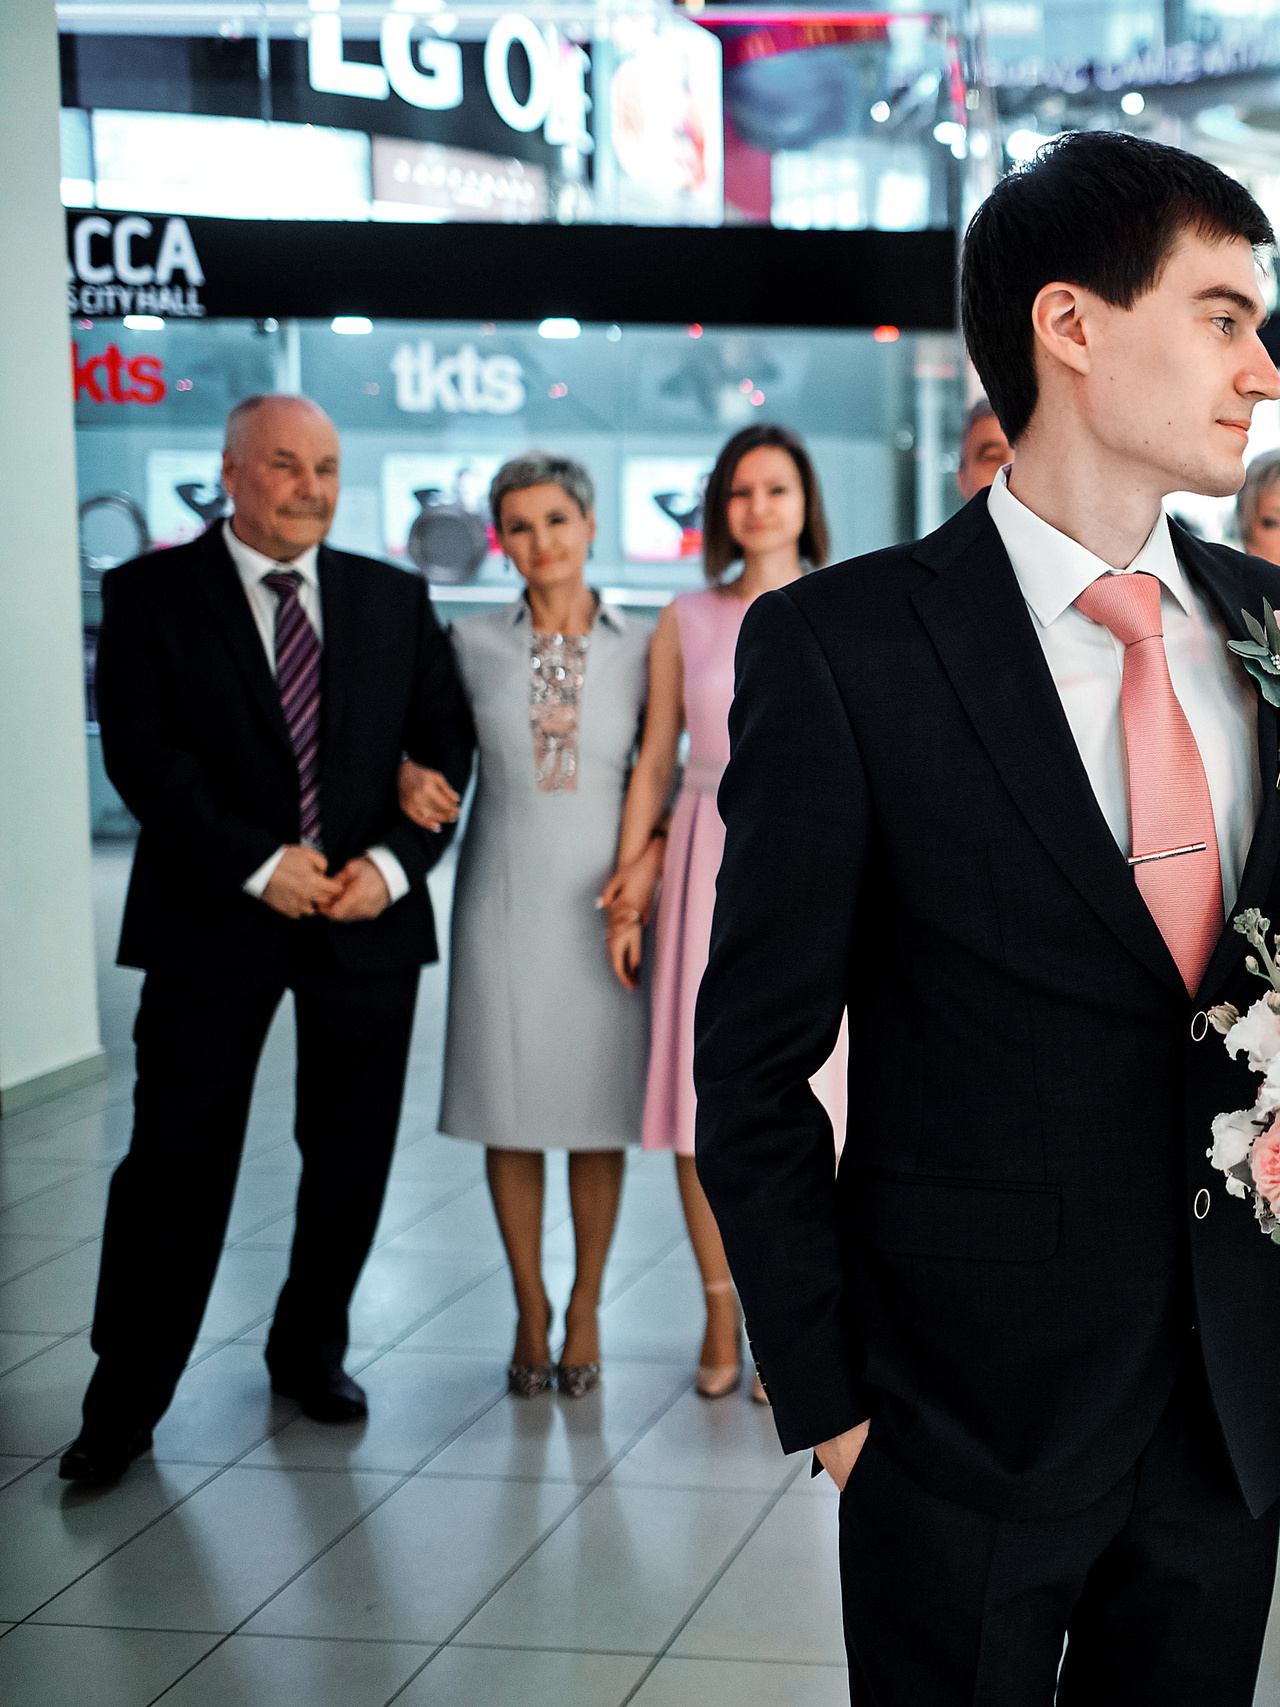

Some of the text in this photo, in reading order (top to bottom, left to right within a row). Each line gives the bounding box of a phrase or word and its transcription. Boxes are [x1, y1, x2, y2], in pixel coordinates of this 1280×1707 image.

[308, 0, 464, 110] LG
[68, 215, 206, 287] CCA
[135, 285, 207, 317] HALL
[71, 341, 167, 405] kts
[390, 339, 526, 414] tkts
